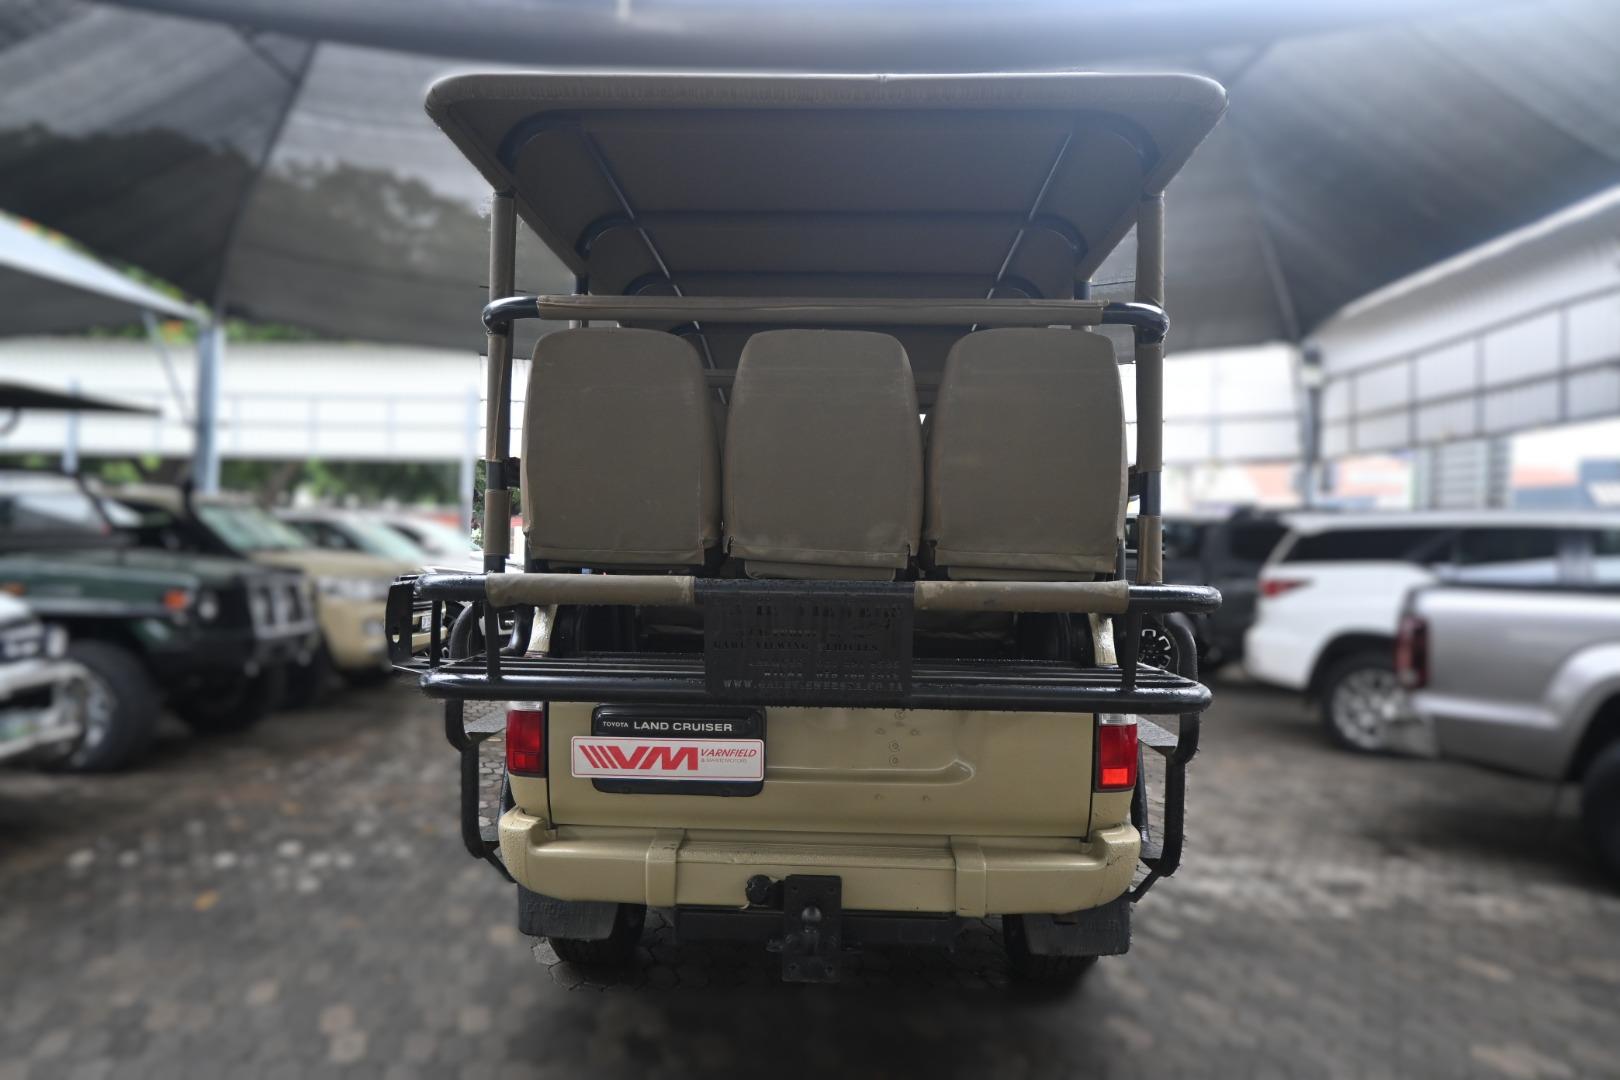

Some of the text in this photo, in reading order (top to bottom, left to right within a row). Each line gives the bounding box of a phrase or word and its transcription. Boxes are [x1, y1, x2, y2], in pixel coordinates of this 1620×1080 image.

[602, 720, 733, 732] TOYOTA LAND CRUISER
[701, 748, 757, 758] VARNFIELD
